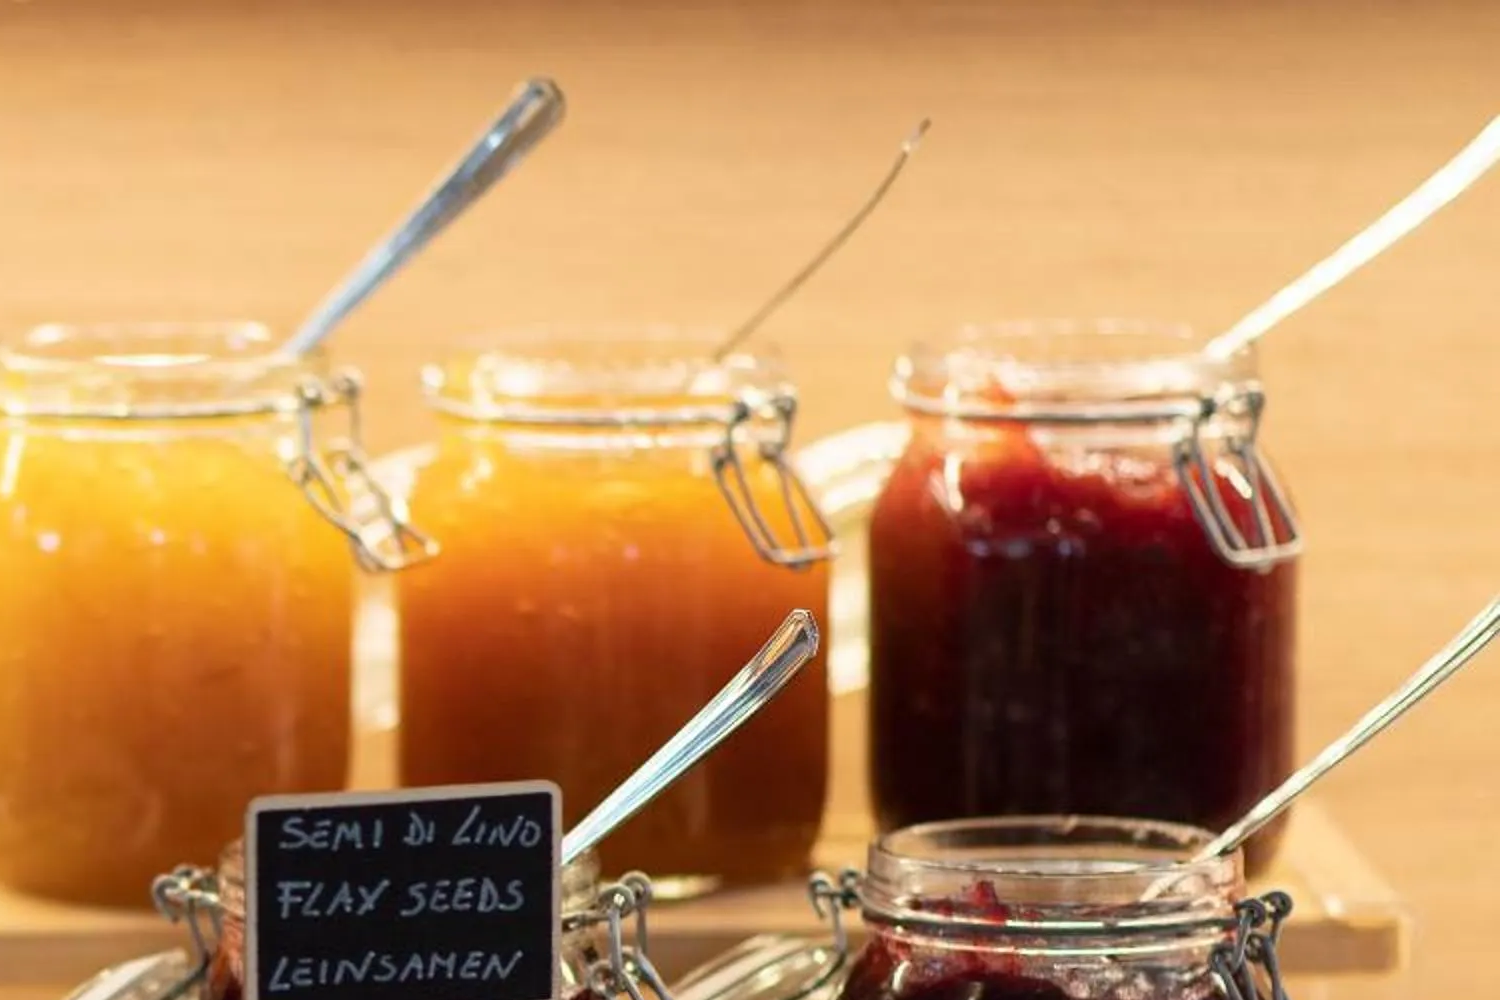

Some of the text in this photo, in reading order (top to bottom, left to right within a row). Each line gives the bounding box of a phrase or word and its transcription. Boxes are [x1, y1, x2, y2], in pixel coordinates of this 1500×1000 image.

[278, 805, 542, 851] SEMI DI LINO
[276, 877, 525, 919] FLAX SEEDS
[268, 950, 524, 991] LEINSAMEN
